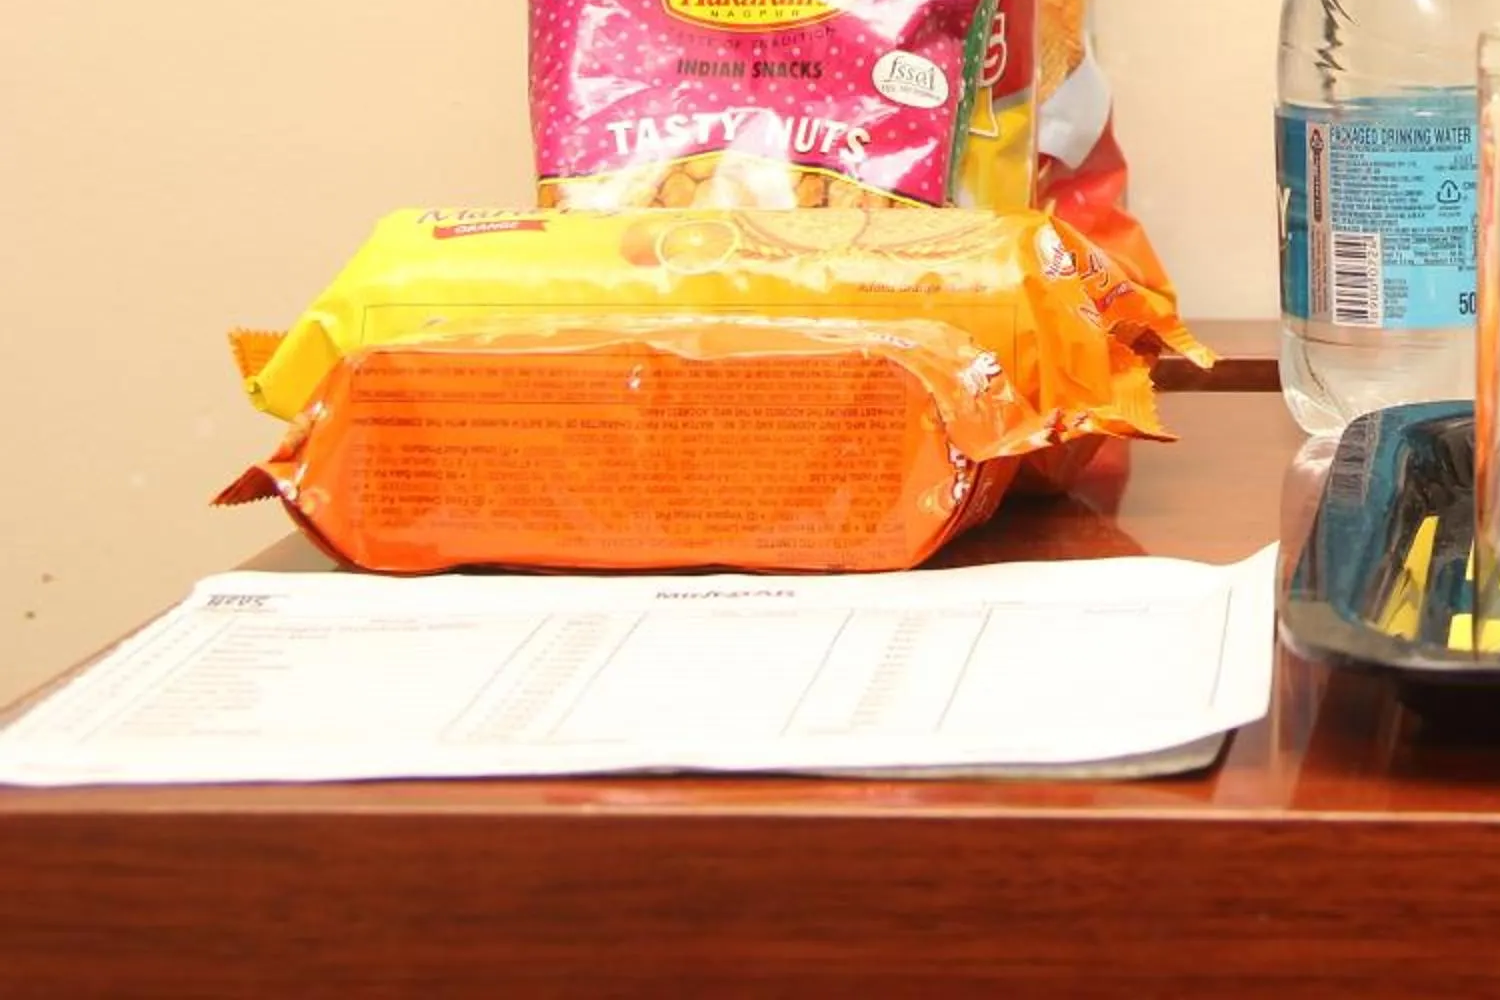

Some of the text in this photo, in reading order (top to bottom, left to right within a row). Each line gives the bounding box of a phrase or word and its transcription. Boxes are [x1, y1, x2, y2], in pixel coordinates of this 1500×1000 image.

[677, 58, 824, 79] INDIAN SNACKS
[607, 111, 871, 164] TASTY NUTS
[1330, 126, 1472, 145] PACKAGED DRINKING WATER
